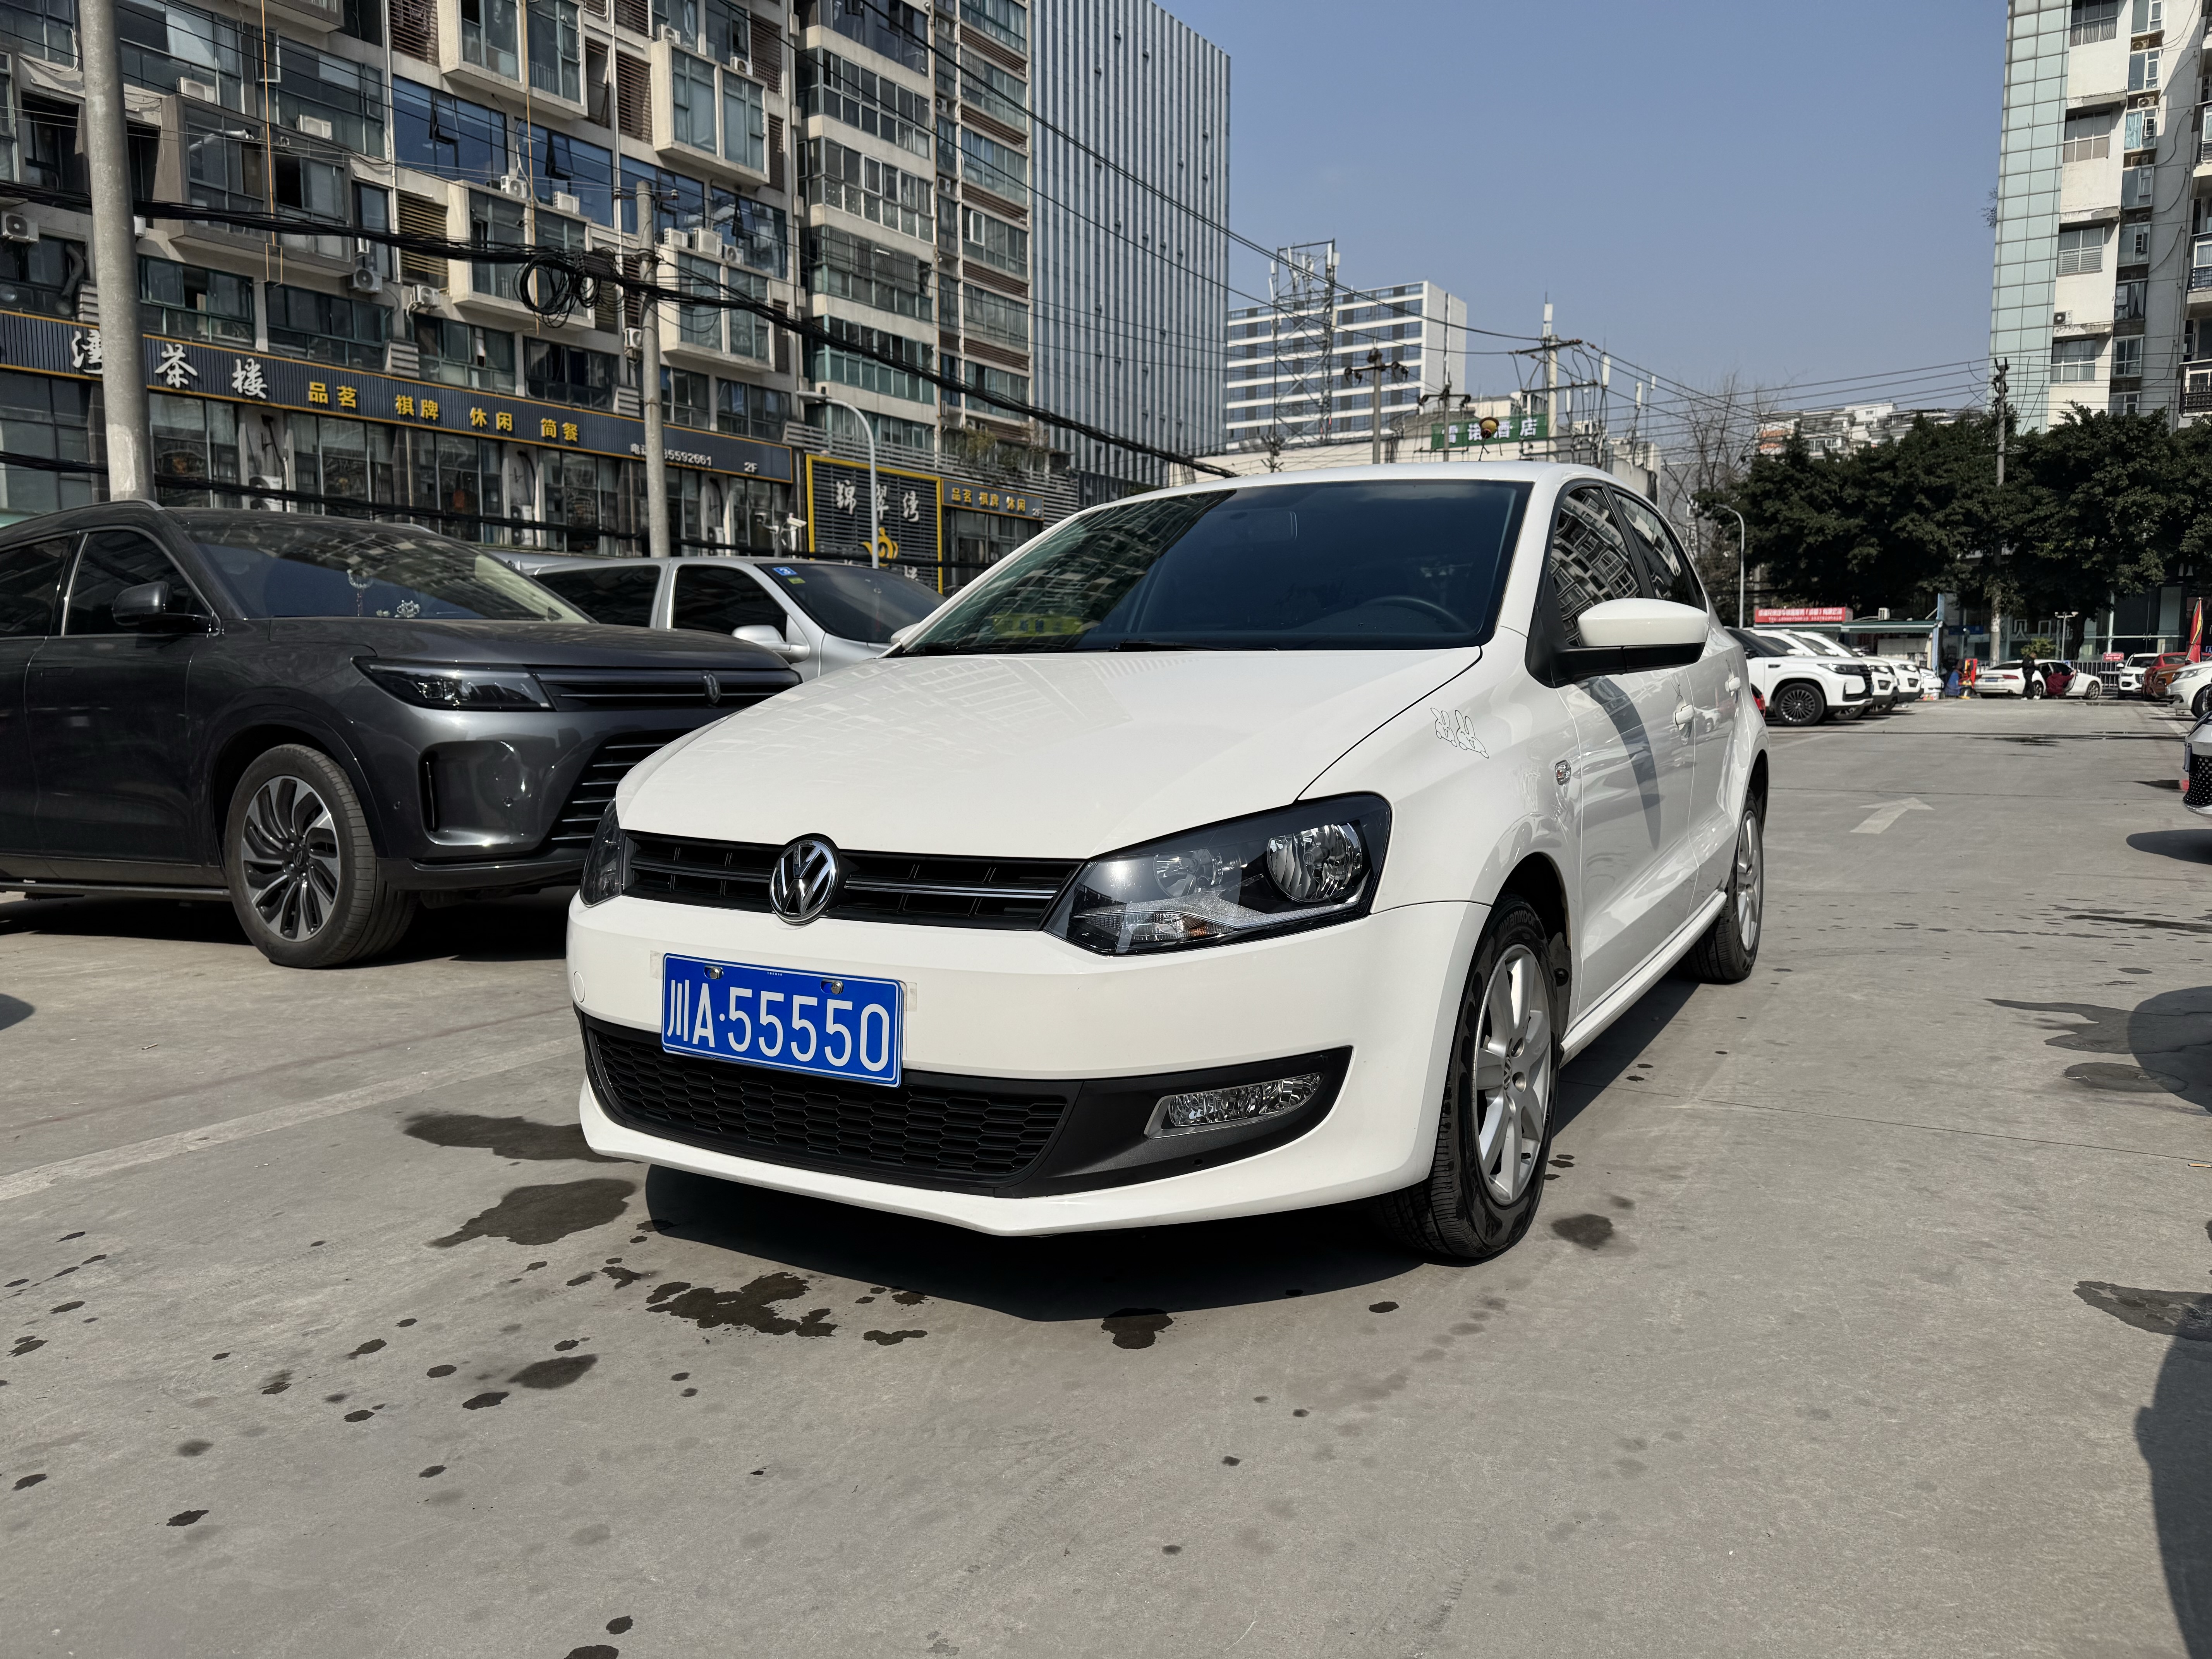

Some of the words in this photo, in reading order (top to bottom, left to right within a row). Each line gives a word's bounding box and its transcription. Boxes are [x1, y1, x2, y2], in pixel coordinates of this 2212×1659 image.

[309, 381, 357, 408] 品茗
[395, 395, 439, 421] 棋牌
[470, 407, 512, 431] 休闲
[541, 418, 578, 442] 简餐
[744, 462, 757, 473] 2F
[951, 488, 972, 503] 品茗
[979, 492, 999, 507] 棋牌
[1006, 496, 1025, 512] 休闲
